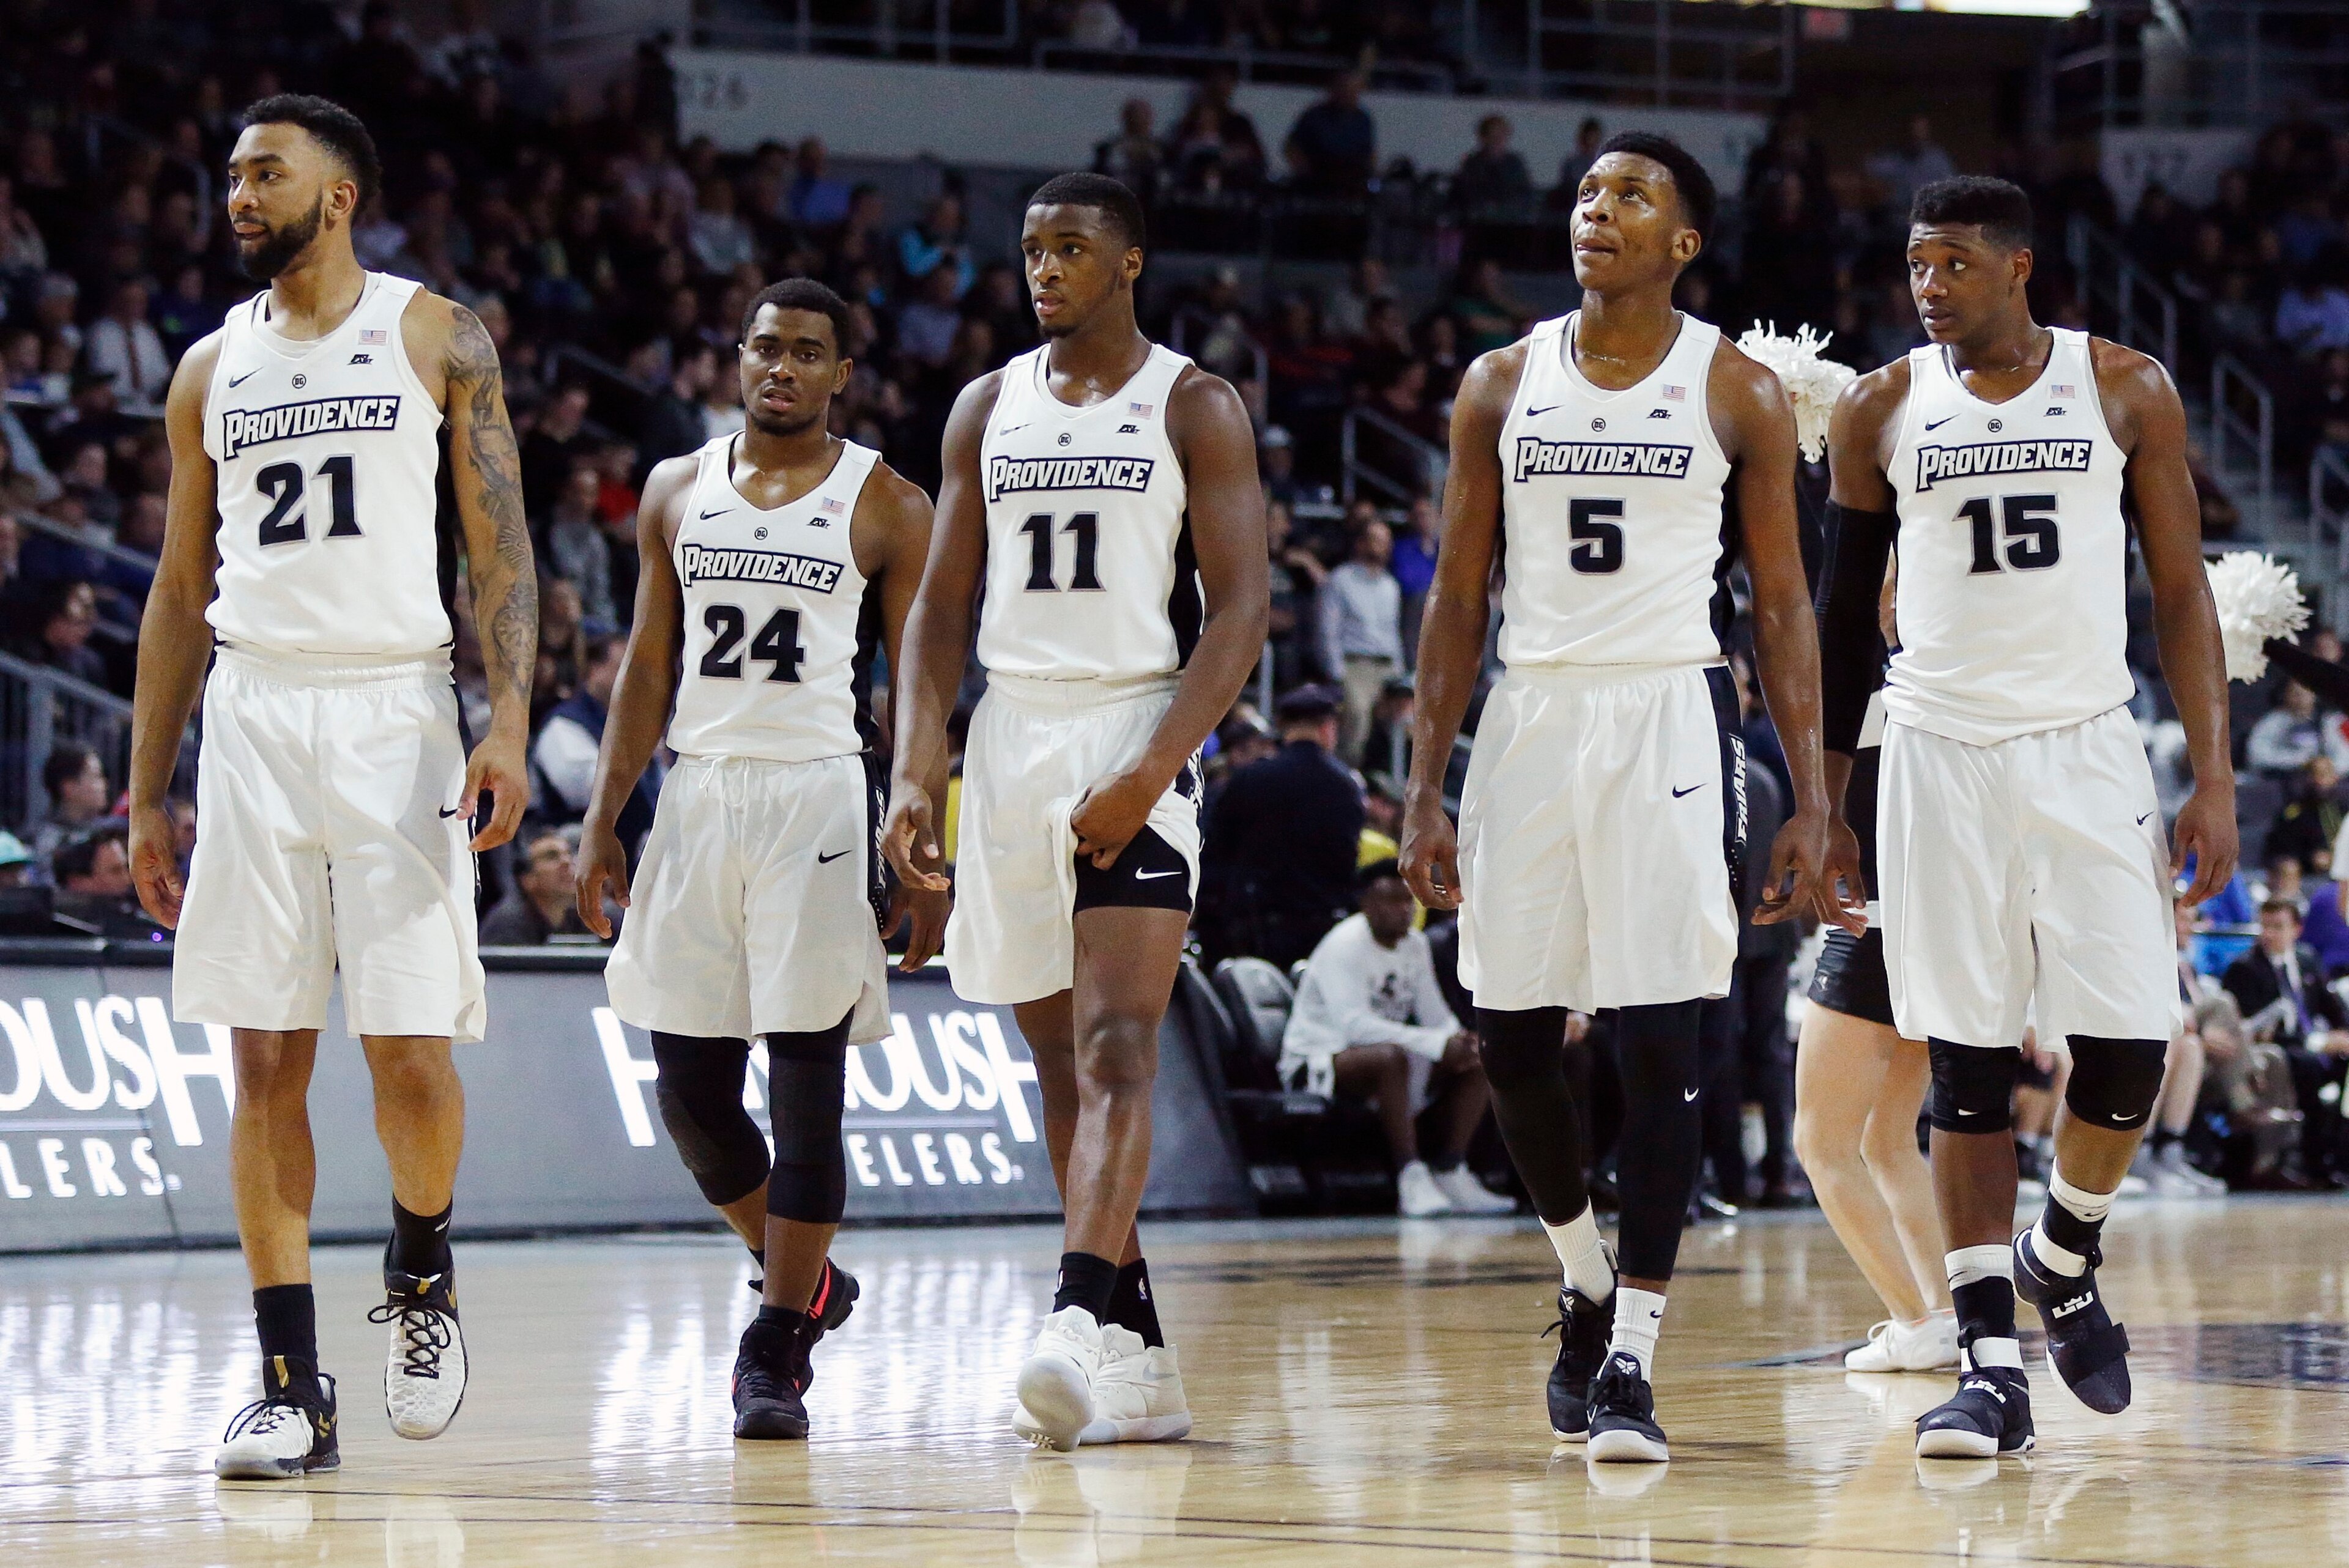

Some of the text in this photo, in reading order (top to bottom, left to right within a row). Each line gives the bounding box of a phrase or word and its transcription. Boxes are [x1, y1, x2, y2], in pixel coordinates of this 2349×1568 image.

[223, 396, 399, 460] PROVIDENCE
[1515, 438, 1691, 481] PROVIDENCE
[990, 457, 1152, 501] PROVIDENCE
[1917, 440, 2091, 491] PROVIDENCE
[254, 454, 366, 550] 21
[1568, 497, 1625, 575] 5
[1953, 493, 2062, 575] 15
[683, 545, 842, 593] PROVIDENCE
[1018, 511, 1106, 592] 11
[700, 602, 807, 685] 24
[1730, 736, 1748, 843] FRIARS
[847, 1133, 1024, 1186] ELERS.
